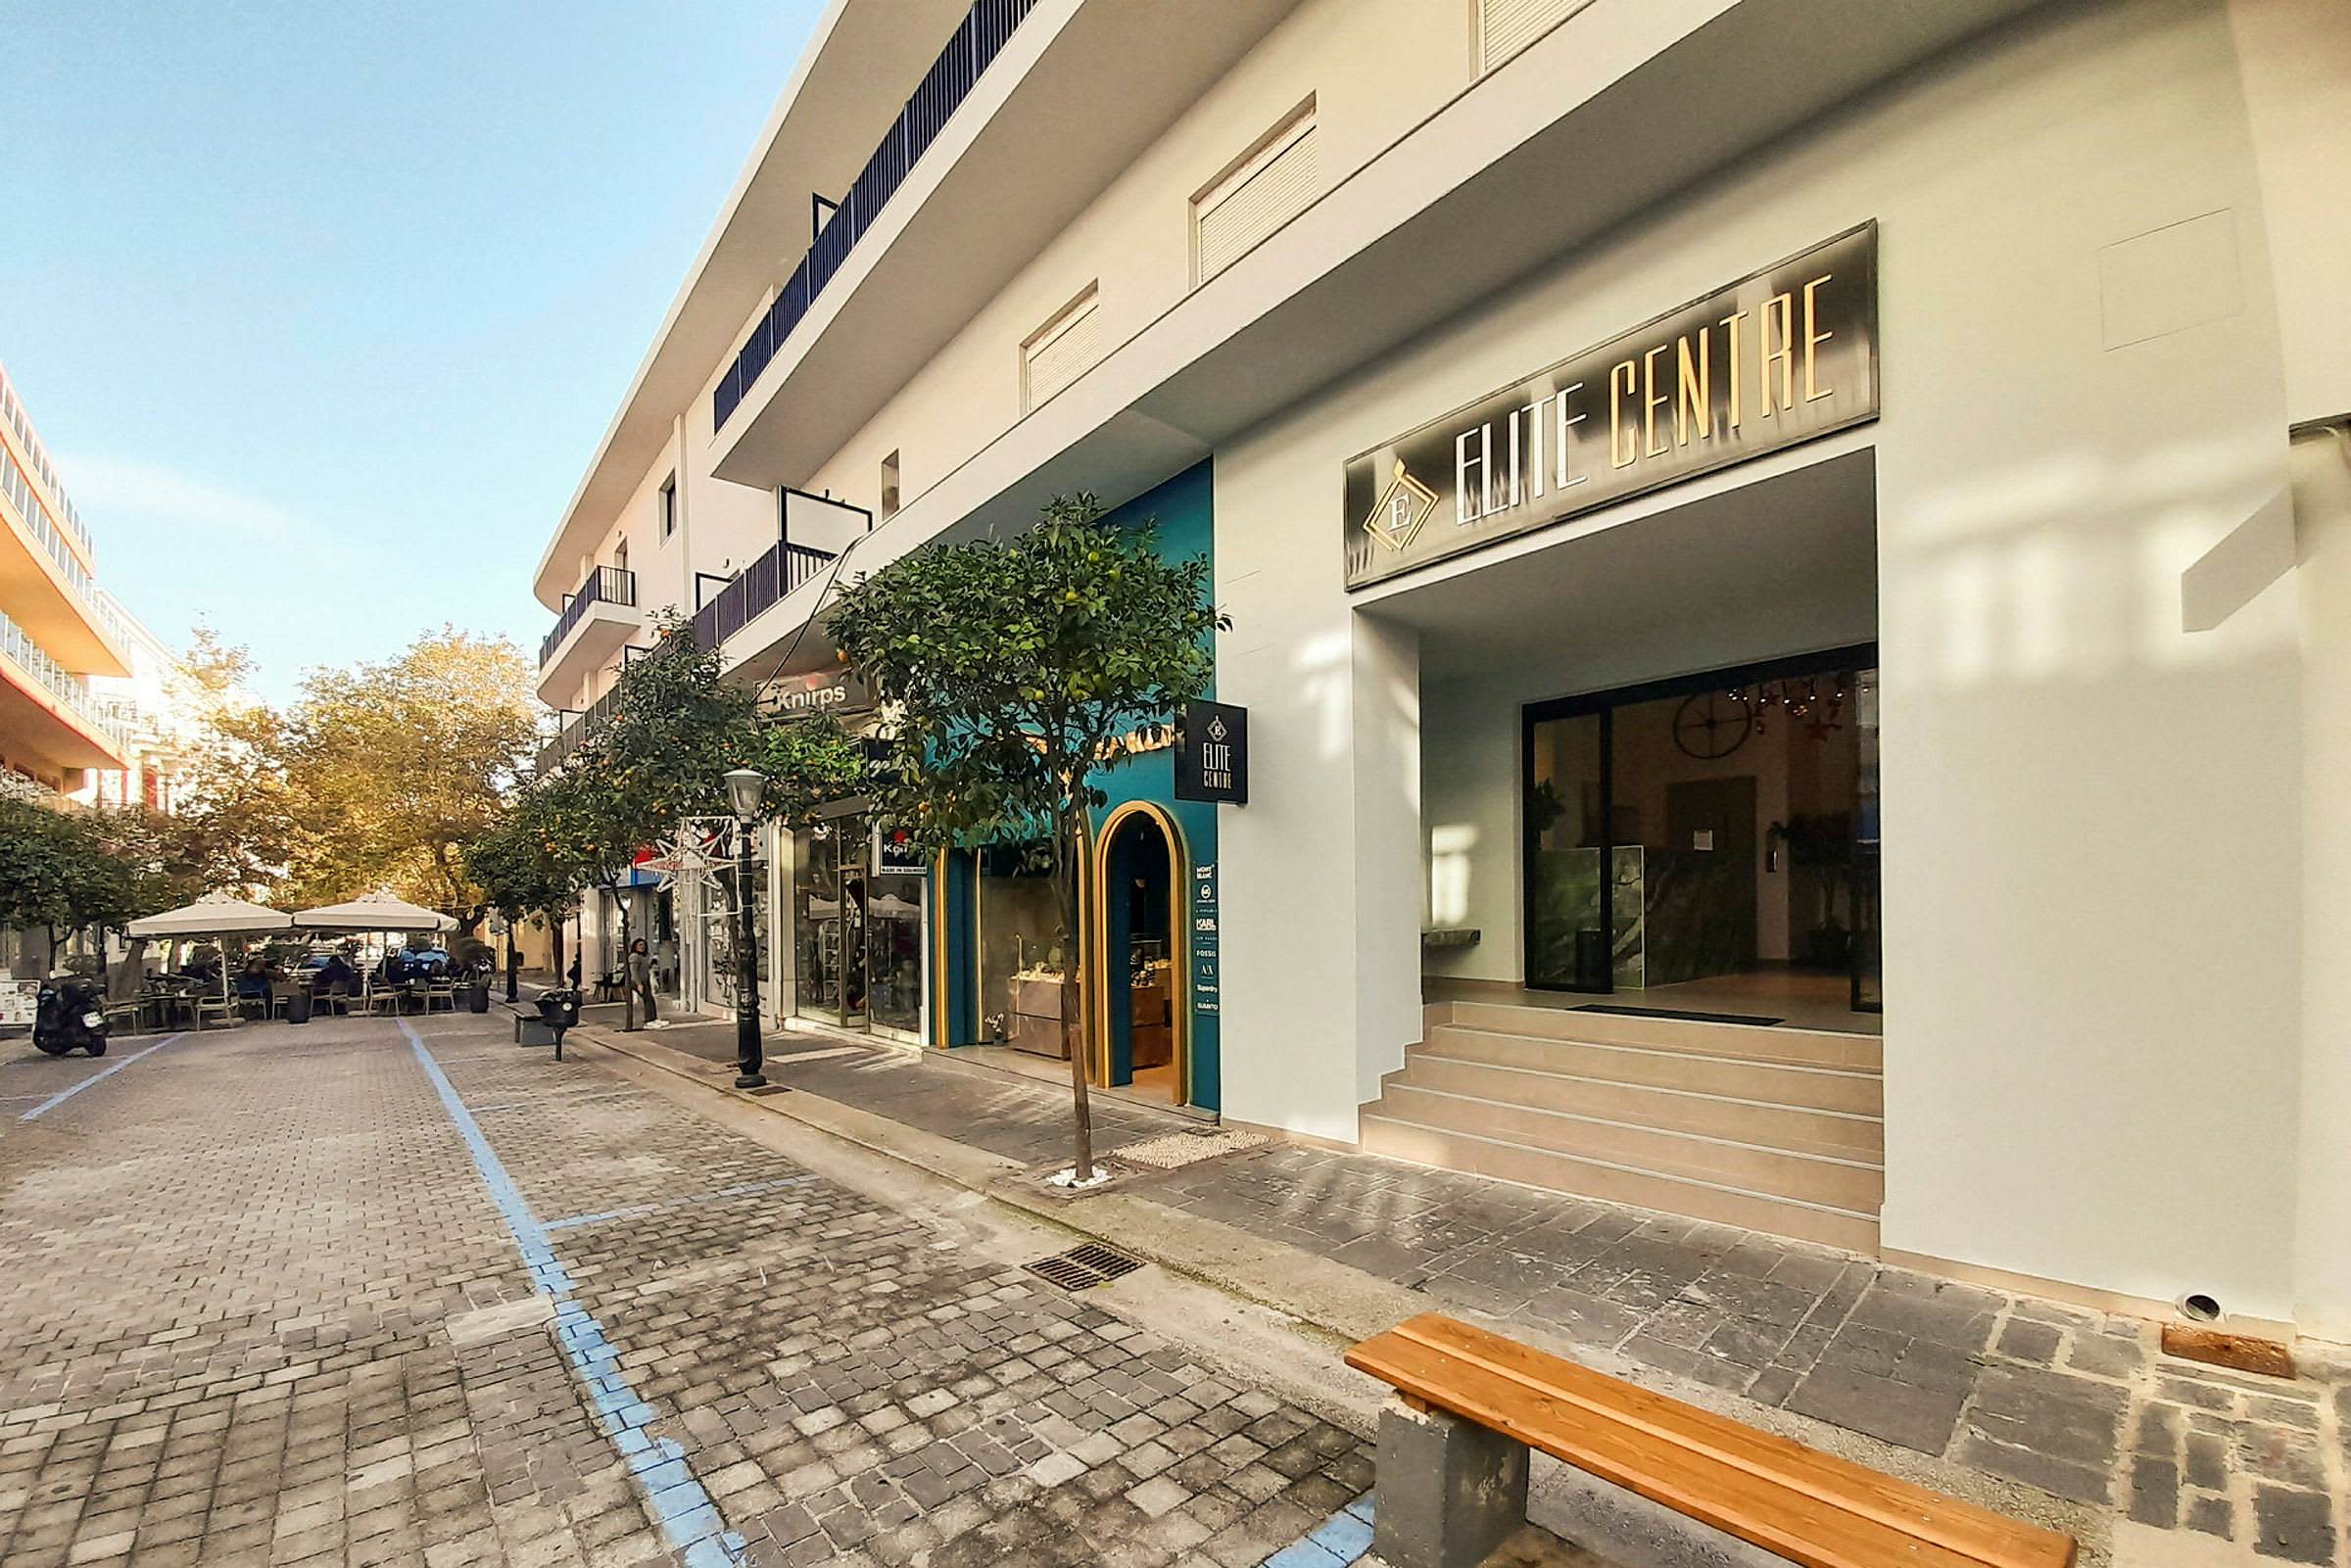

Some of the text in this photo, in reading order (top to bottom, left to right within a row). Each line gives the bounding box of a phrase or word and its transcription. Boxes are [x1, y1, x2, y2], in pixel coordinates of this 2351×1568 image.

[1455, 274, 1835, 525] ELITE CENTRE
[1388, 493, 1414, 532] E
[777, 686, 846, 714] Knirps
[1203, 742, 1231, 772] ELITE
[1203, 771, 1231, 789] CENTRE
[1196, 949, 1217, 958] FOSSIL
